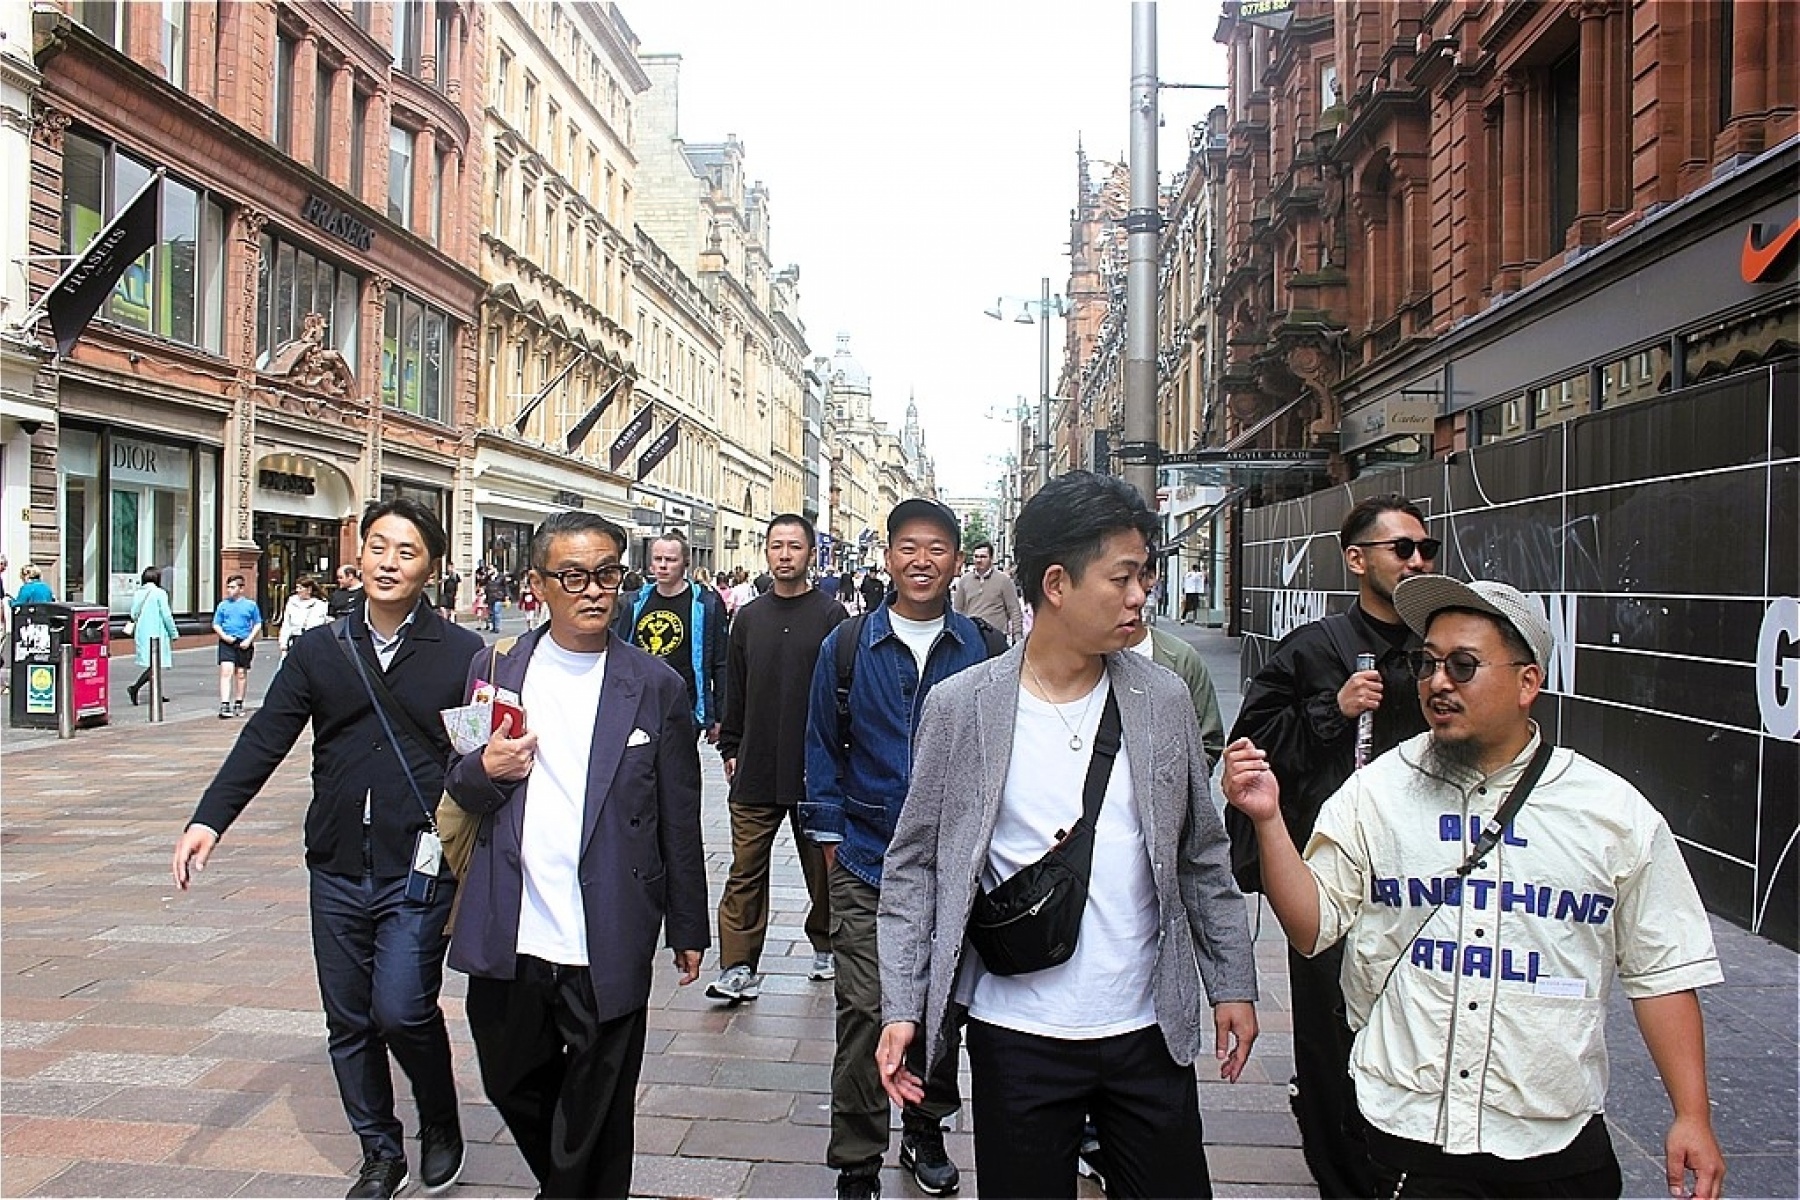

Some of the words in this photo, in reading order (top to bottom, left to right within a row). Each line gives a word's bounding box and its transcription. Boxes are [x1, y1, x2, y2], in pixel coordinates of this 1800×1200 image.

[303, 195, 377, 250] FRASERS
[64, 228, 127, 294] FRASERS
[1391, 411, 1428, 424] Cartier
[113, 443, 157, 473] DIOR
